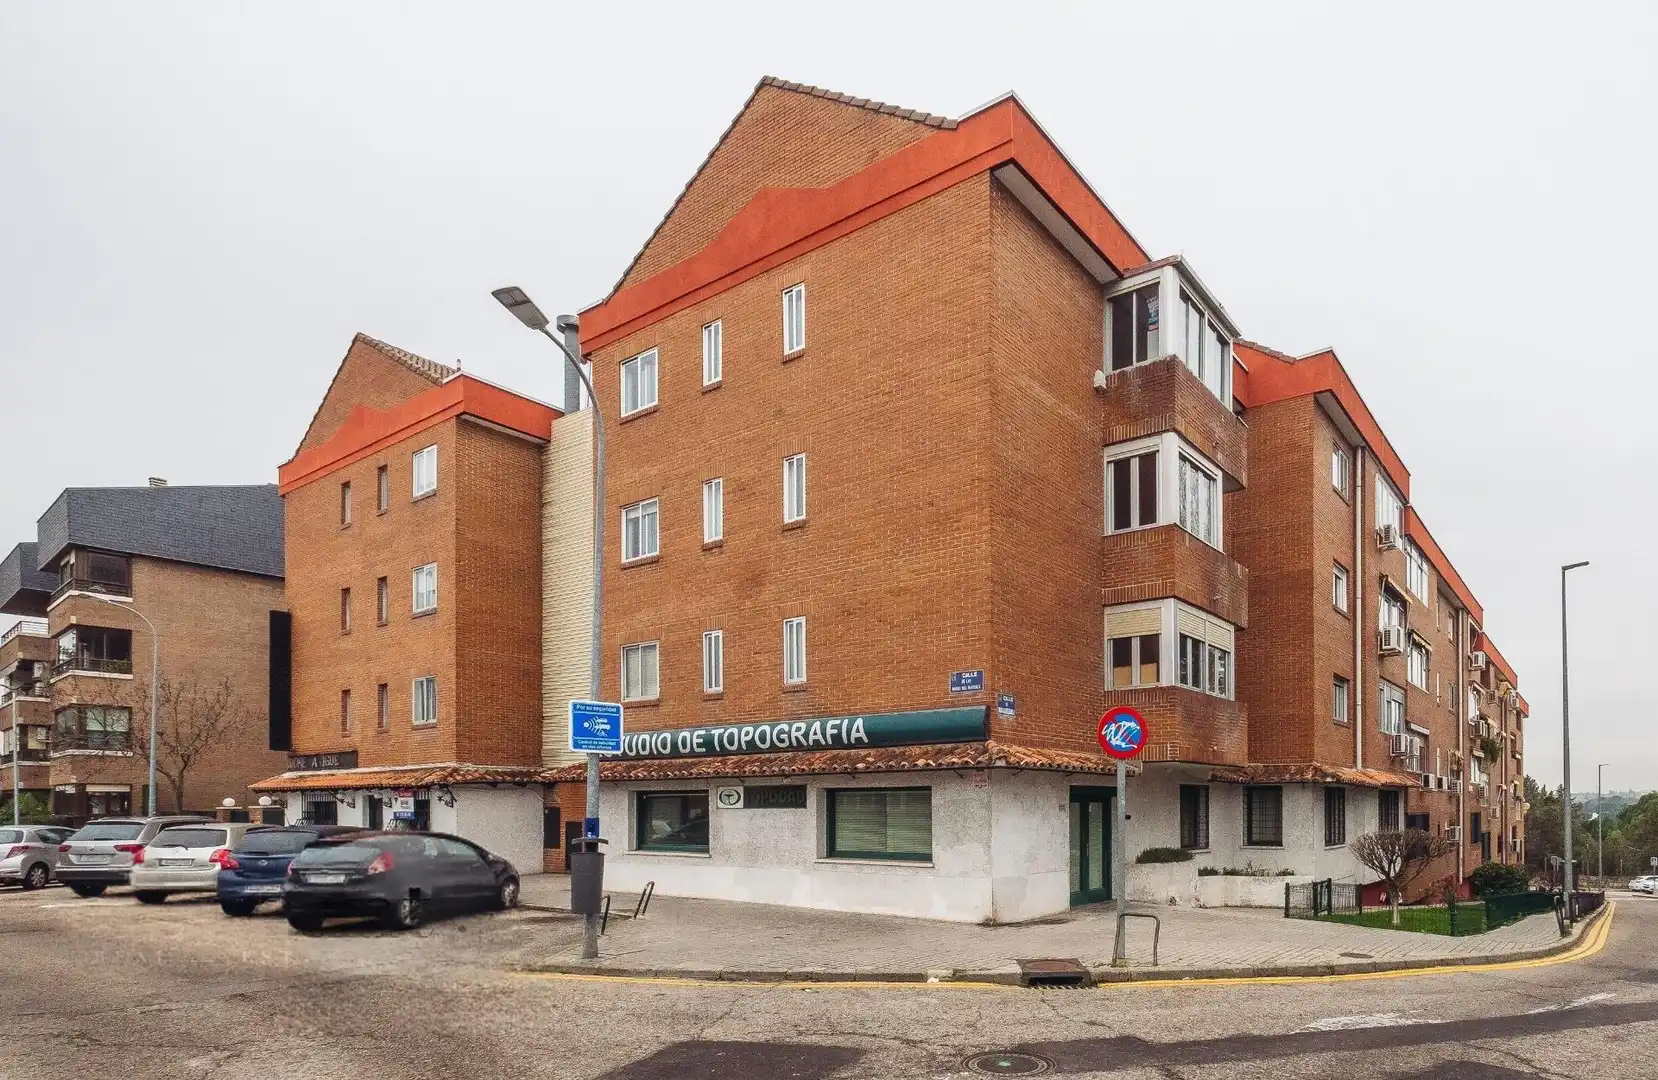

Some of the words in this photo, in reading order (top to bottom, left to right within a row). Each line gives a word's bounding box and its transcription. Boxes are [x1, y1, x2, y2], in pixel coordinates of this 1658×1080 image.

[599, 732, 671, 757] UDIO
[678, 729, 706, 754] DE
[712, 717, 869, 752] TOPOGRAFIA
